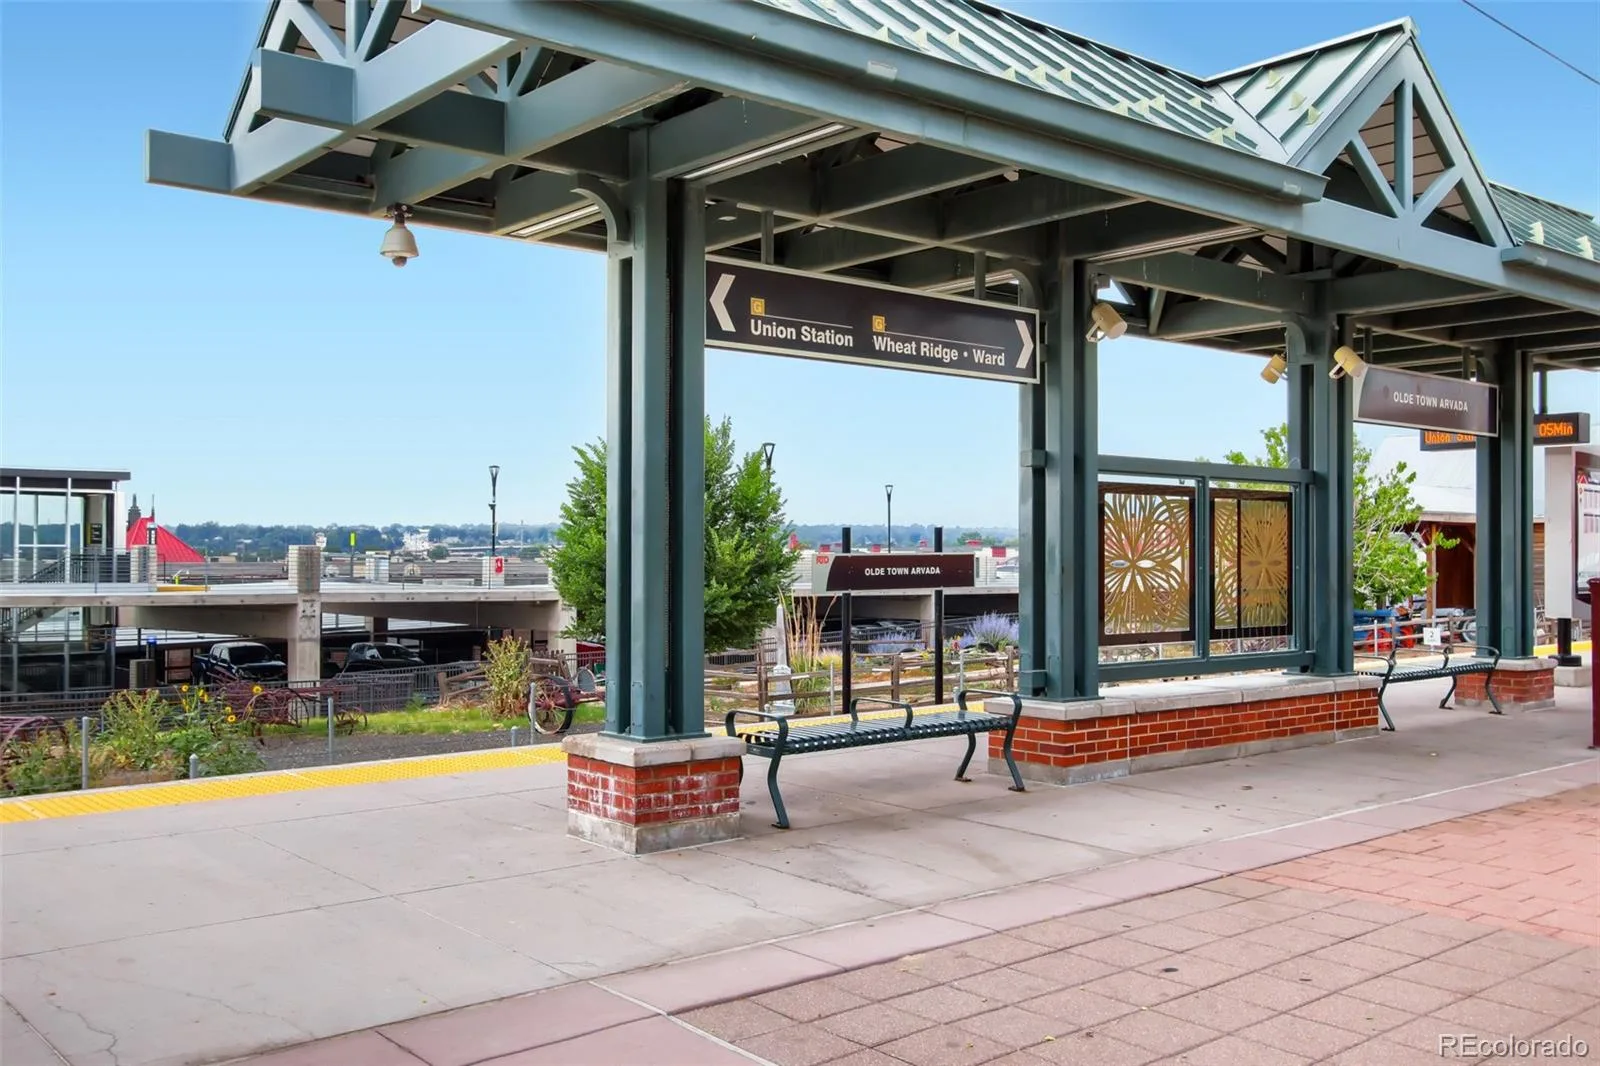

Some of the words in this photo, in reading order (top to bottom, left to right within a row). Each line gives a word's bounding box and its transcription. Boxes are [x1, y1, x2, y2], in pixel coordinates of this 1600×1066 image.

[752, 300, 763, 314] G
[874, 317, 884, 331] G
[750, 319, 797, 340] Union
[800, 325, 853, 347] Station
[873, 335, 917, 355] Wheat
[920, 341, 958, 363] Ridge
[973, 349, 1005, 366] Ward
[1393, 391, 1414, 405] OLDE
[1415, 394, 1438, 408] TOWN
[1439, 398, 1469, 412] ARVADA
[1539, 422, 1573, 437] 05Min
[1424, 431, 1450, 444] Union
[864, 568, 885, 576] OLDE
[887, 567, 909, 575] TOWN
[910, 566, 941, 575] ARVADA
